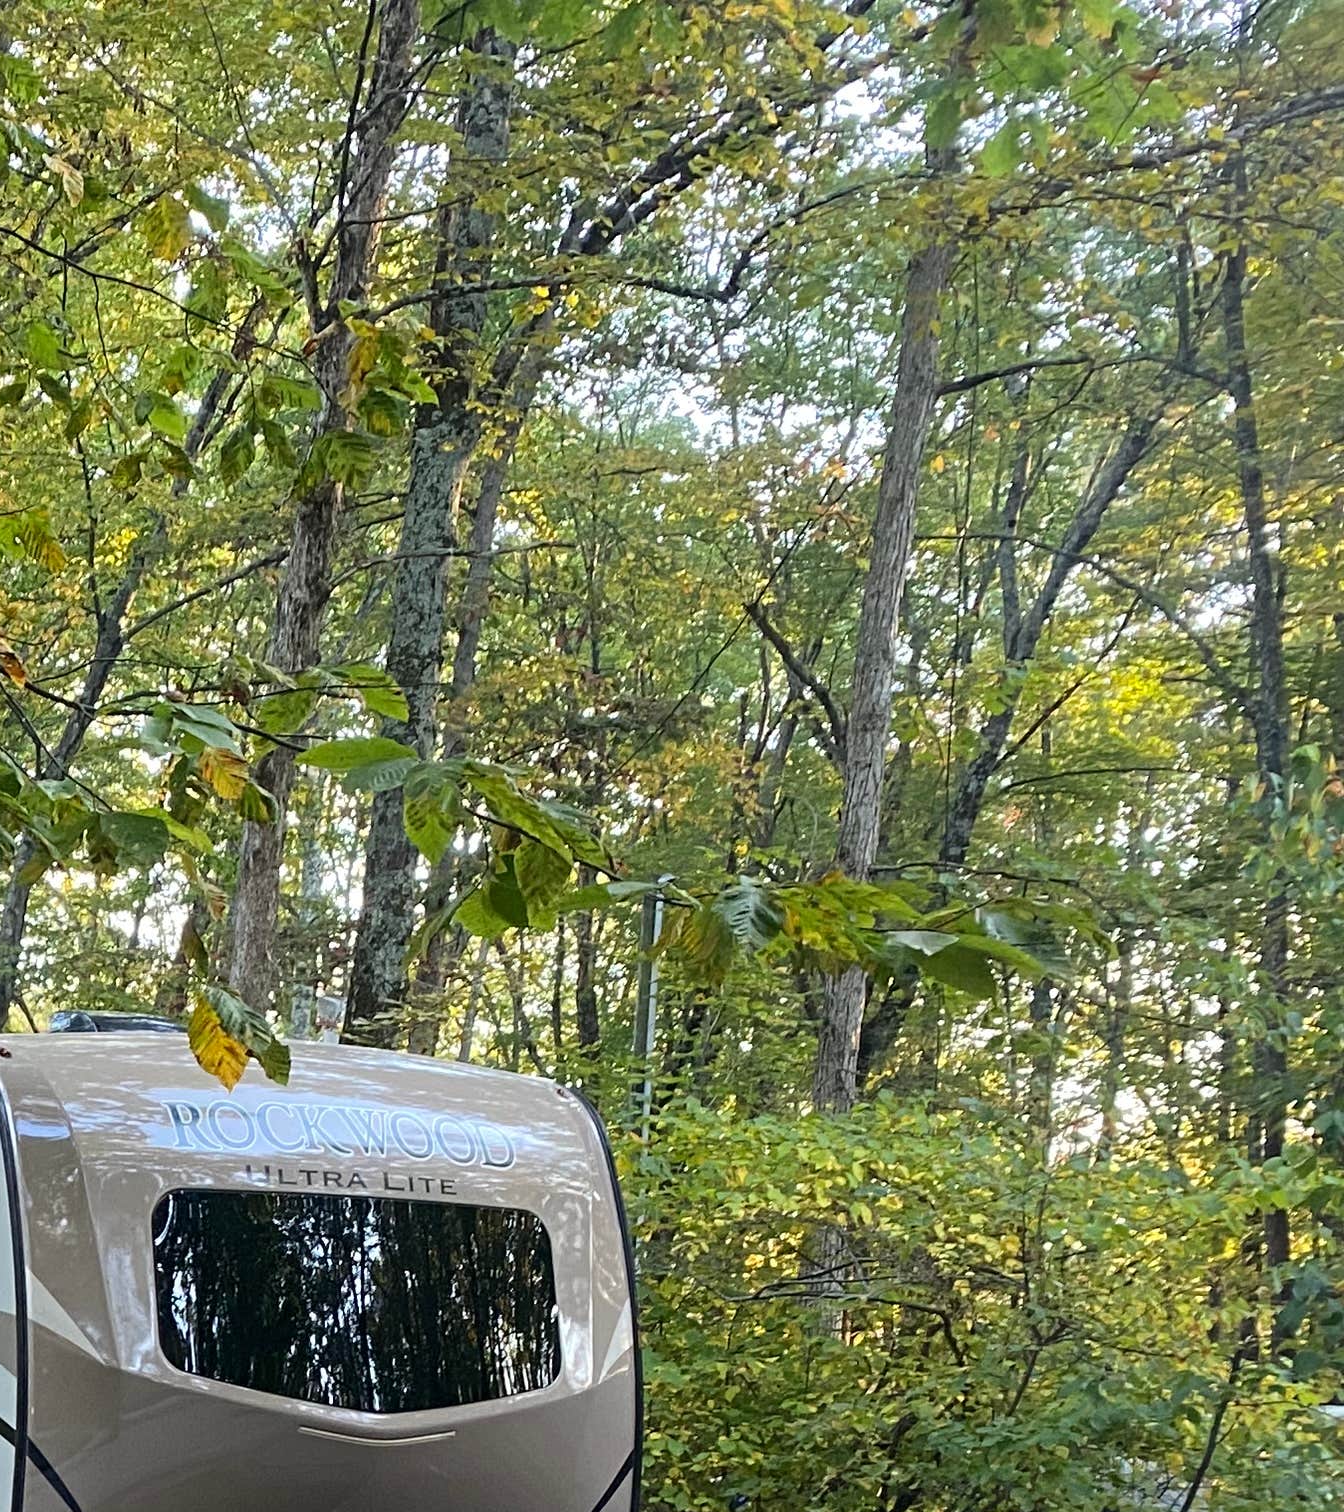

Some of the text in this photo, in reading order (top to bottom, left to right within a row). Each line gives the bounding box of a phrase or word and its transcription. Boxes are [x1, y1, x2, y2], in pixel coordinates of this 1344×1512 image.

[161, 1099, 517, 1170] ROCKWOOD
[245, 1164, 458, 1196] ULTRA LITE
